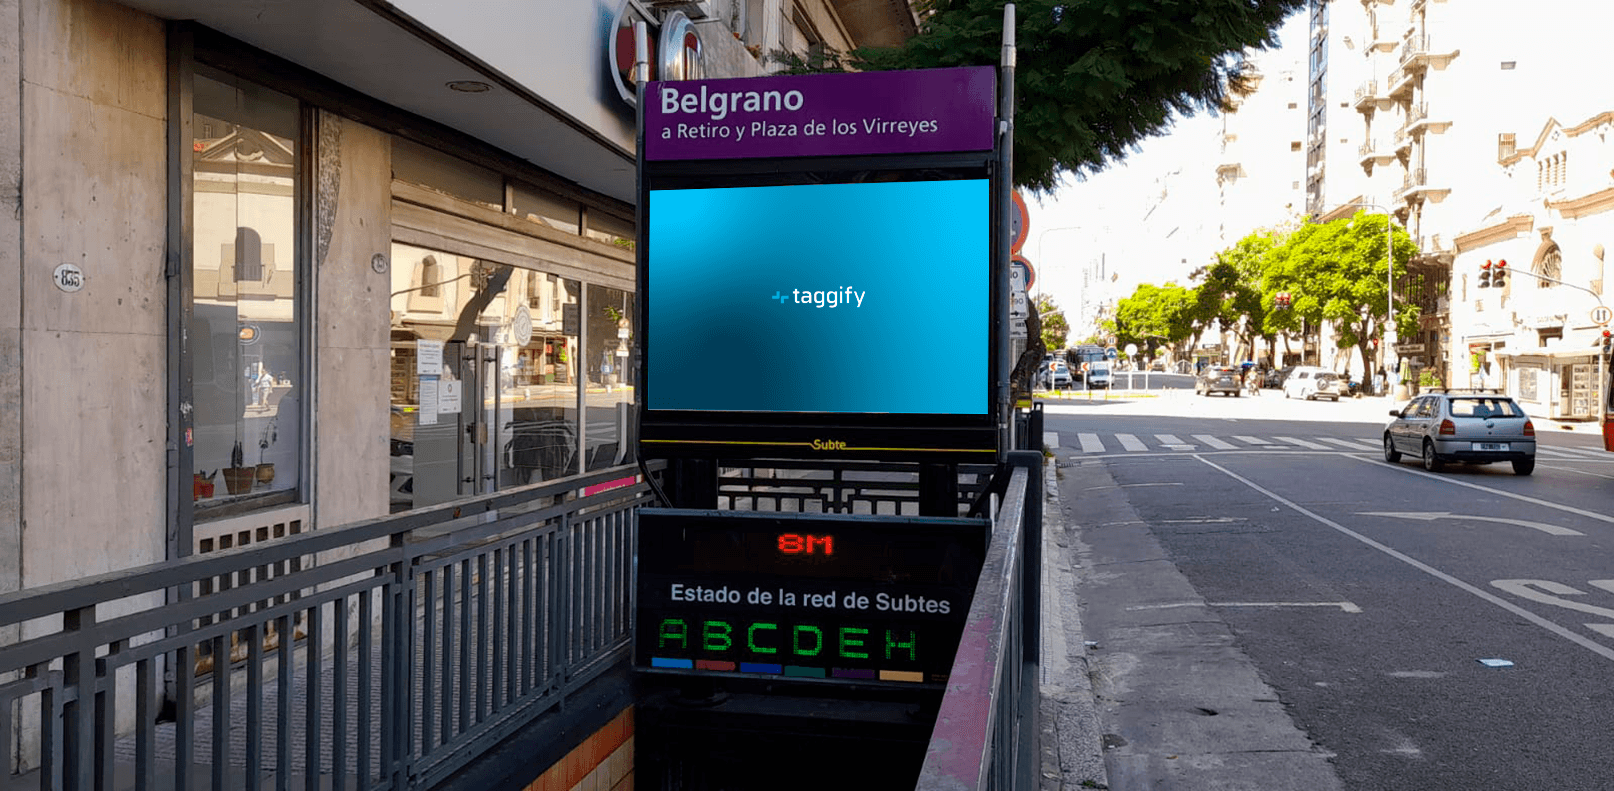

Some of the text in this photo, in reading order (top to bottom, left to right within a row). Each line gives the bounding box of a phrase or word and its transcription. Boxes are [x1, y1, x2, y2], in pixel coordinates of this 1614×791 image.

[661, 85, 804, 120] Belgrano
[661, 117, 938, 142] a Retiro y Plaza de los Virreyes
[792, 285, 866, 309] taggify
[813, 438, 847, 451] Subte
[778, 533, 833, 555] 8M
[671, 583, 950, 614] Estado de la red de Subtes
[659, 618, 916, 661] A B C D E H
